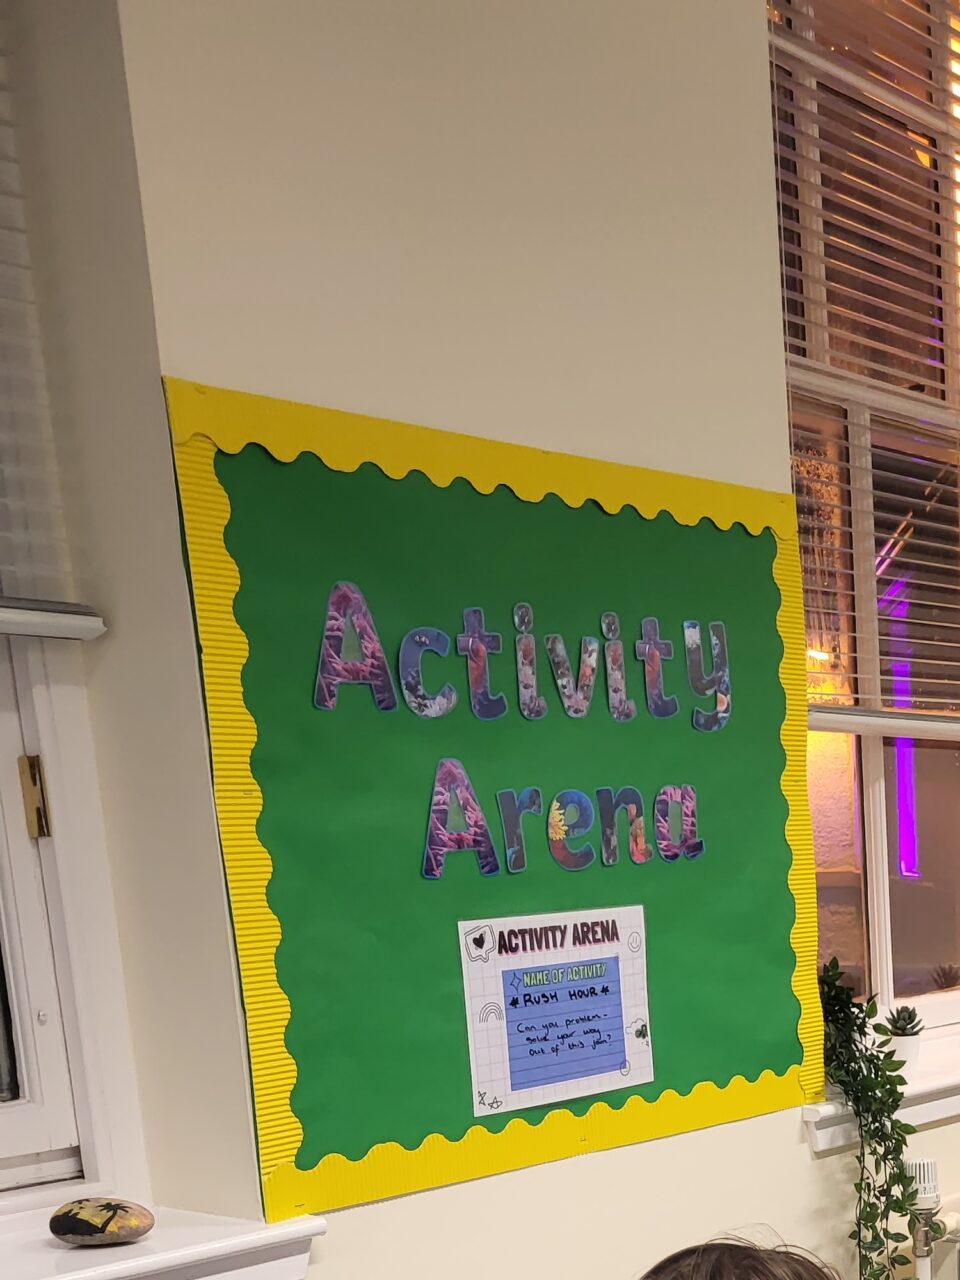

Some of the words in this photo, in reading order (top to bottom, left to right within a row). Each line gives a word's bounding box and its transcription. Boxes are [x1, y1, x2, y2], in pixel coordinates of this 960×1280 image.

[314, 580, 732, 732] Activity
[421, 757, 704, 880] Arena
[497, 924, 568, 955] ACTIVITY
[572, 918, 621, 946] ARENA
[523, 969, 550, 989] NAME
[551, 967, 566, 984] OF
[567, 962, 607, 982] ACTIVITY
[568, 986, 598, 1001] HOUR
[516, 1022, 537, 1033] Can
[541, 1021, 559, 1036] you
[557, 1030, 576, 1046] your
[583, 1027, 602, 1041] way
[551, 1044, 560, 1057] of
[568, 1040, 585, 1050] this
